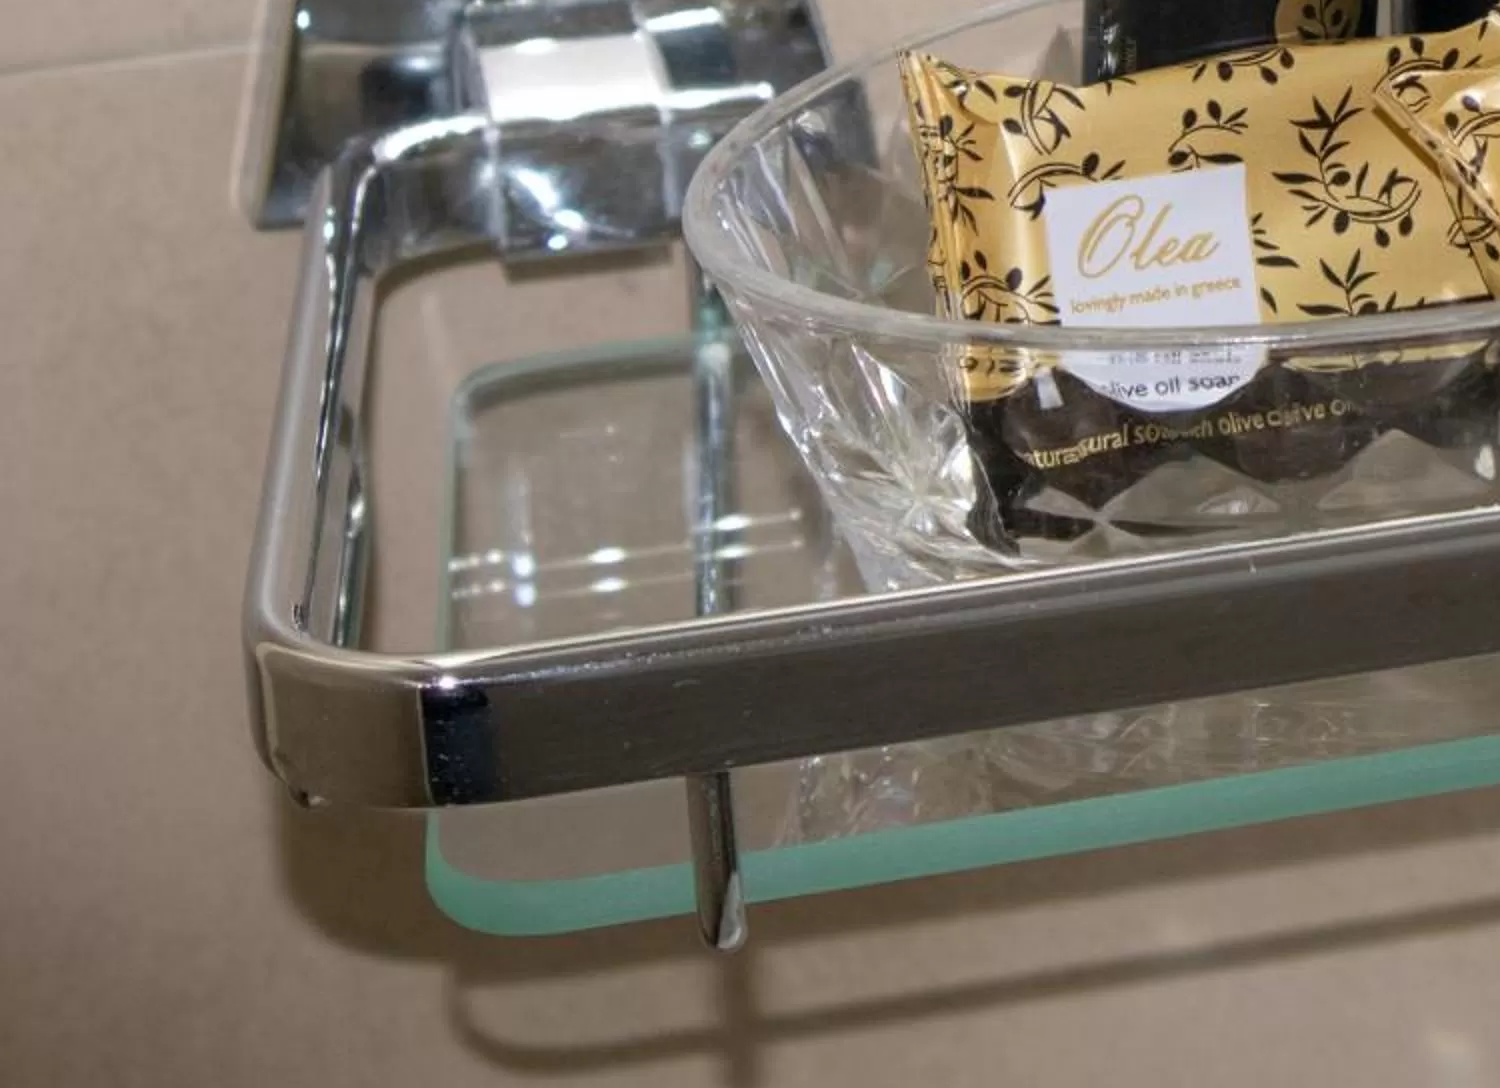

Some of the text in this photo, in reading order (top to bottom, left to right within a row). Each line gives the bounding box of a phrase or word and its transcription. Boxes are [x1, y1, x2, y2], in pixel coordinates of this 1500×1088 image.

[1077, 193, 1221, 279] Olea
[1070, 275, 1242, 314] lovingly made in greece
[1154, 375, 1181, 396] oil
